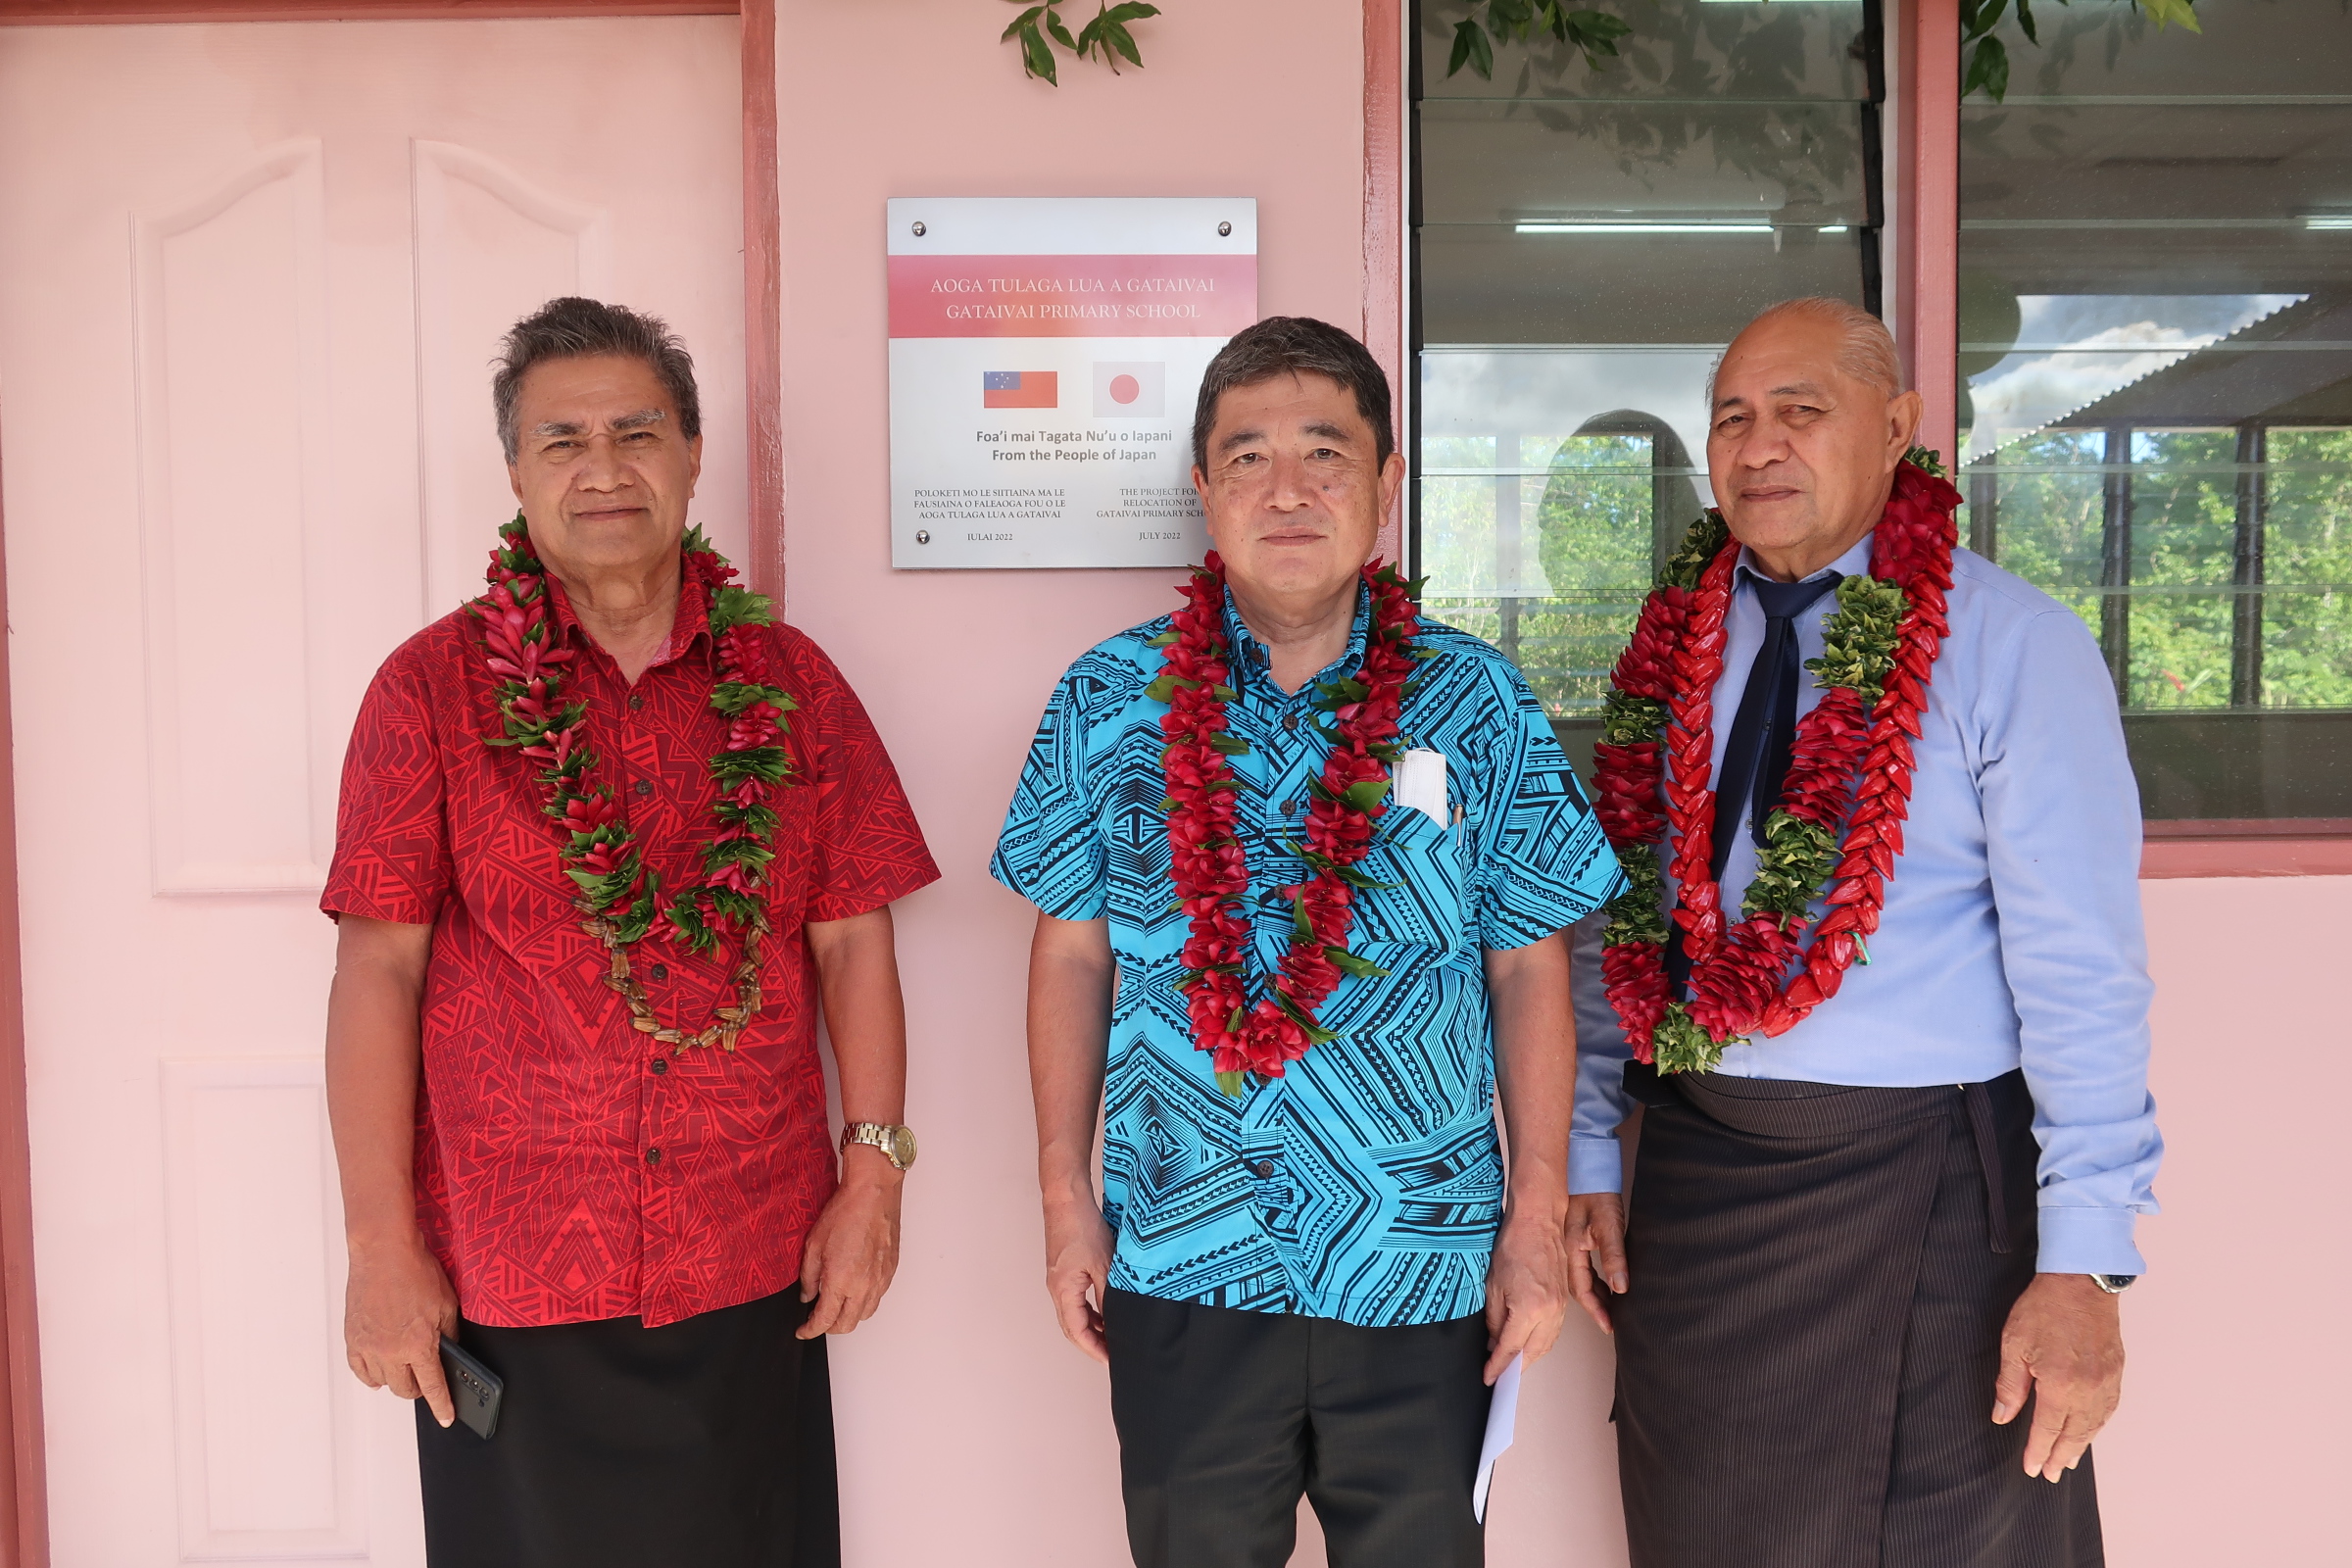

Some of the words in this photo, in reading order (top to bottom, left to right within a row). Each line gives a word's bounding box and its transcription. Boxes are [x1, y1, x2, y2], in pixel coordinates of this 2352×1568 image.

[931, 278, 984, 293] AOGA
[988, 278, 1063, 293] TULAGA
[1068, 278, 1105, 292] LUA
[1109, 278, 1123, 292] A
[1127, 277, 1215, 292] GATAIVAI
[946, 305, 1035, 319] GATAIVAI
[1039, 304, 1122, 318] PRIMARY
[1126, 304, 1201, 318] SCHOOL
[1011, 430, 1035, 442] mai
[1039, 430, 1082, 445] Tagata
[1120, 432, 1129, 441] o
[992, 449, 1026, 462] From
[1029, 449, 1052, 461] the
[1054, 449, 1100, 464] People
[1102, 449, 1117, 461] of
[1118, 449, 1156, 463] Japan
[914, 489, 960, 498] POLOKETI
[1038, 488, 1053, 497] MA
[1054, 488, 1065, 497] LE
[1140, 488, 1180, 497] PROJECT
[913, 500, 963, 509] FAUSIAINA
[964, 500, 972, 509] O
[1024, 499, 1044, 508] FOU
[1046, 499, 1054, 508] O
[1054, 499, 1066, 508] LE
[1123, 499, 1183, 508] RELOCATION
[1184, 498, 1198, 507] OF
[918, 511, 946, 519] AOGA
[947, 511, 986, 519] TULAGA
[1016, 510, 1061, 518] GATAIVAI
[1096, 510, 1141, 518] GATAIVAI
[1138, 532, 1160, 541] JULY
